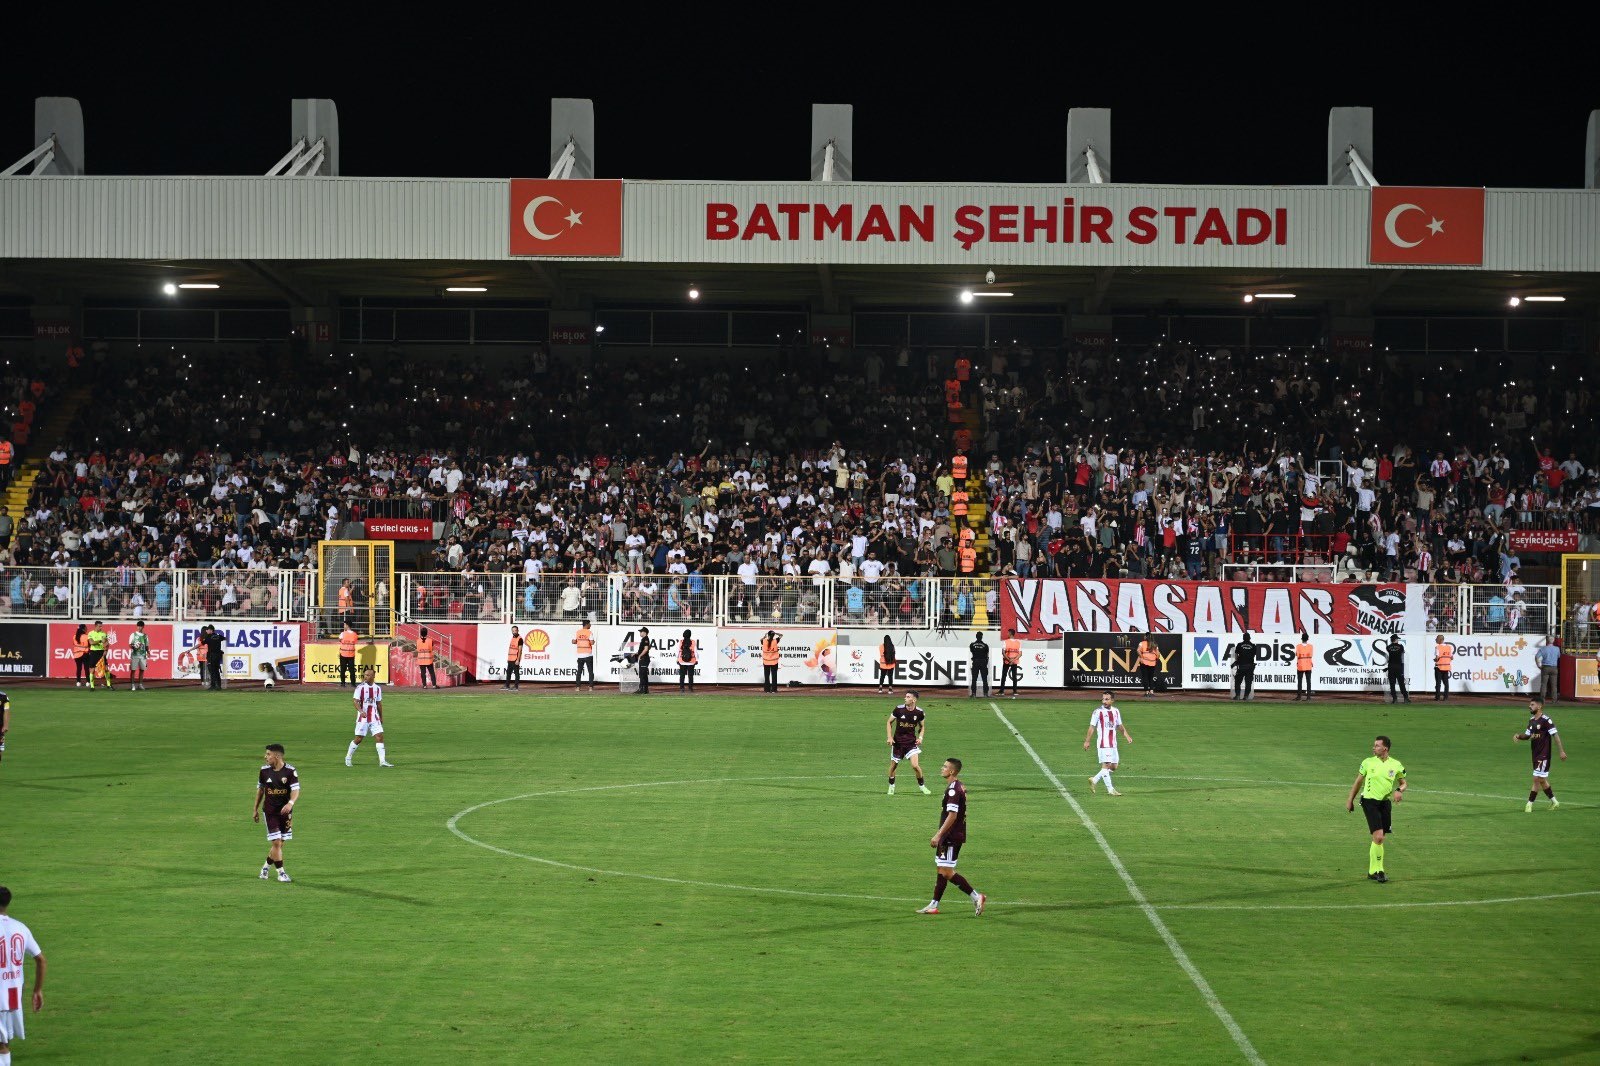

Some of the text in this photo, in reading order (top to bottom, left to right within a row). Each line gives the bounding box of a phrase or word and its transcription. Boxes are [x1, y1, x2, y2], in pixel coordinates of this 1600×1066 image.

[706, 197, 1288, 251] BATMAN ŞEHİR STADI
[370, 524, 398, 532] SEYİRCİ
[400, 525, 418, 533] ÇIKIŞ
[1516, 536, 1543, 544] SEYİRCİ
[311, 663, 340, 675] ÇİÇEK
[488, 666, 500, 676] ÖZ
[1072, 674, 1133, 684] MÜHENDİSLİK
